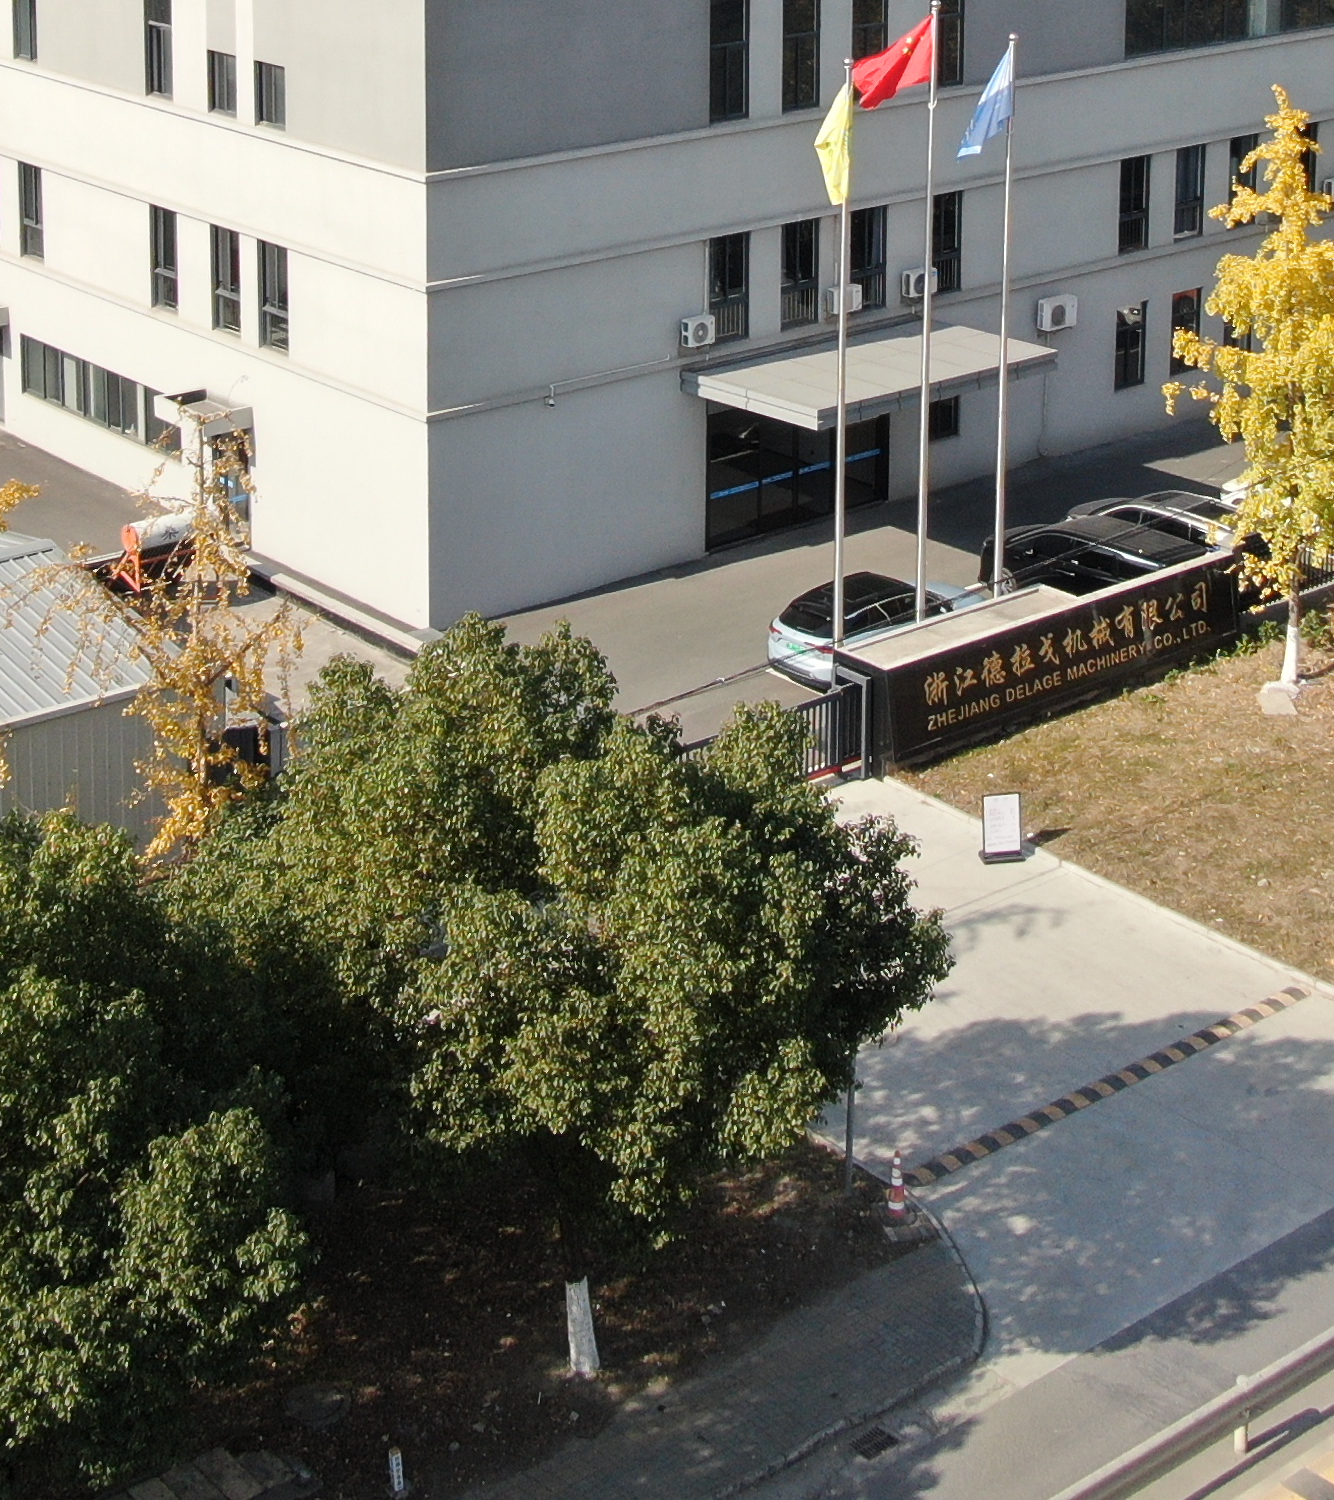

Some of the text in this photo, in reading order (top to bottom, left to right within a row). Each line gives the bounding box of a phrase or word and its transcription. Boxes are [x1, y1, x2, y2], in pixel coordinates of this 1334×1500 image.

[924, 581, 1208, 706] 浙江德拉戈机械有限公司
[927, 694, 1001, 731] ZHEJIANG
[1006, 671, 1062, 702] DELAGE
[1067, 642, 1146, 681] MACHINERY
